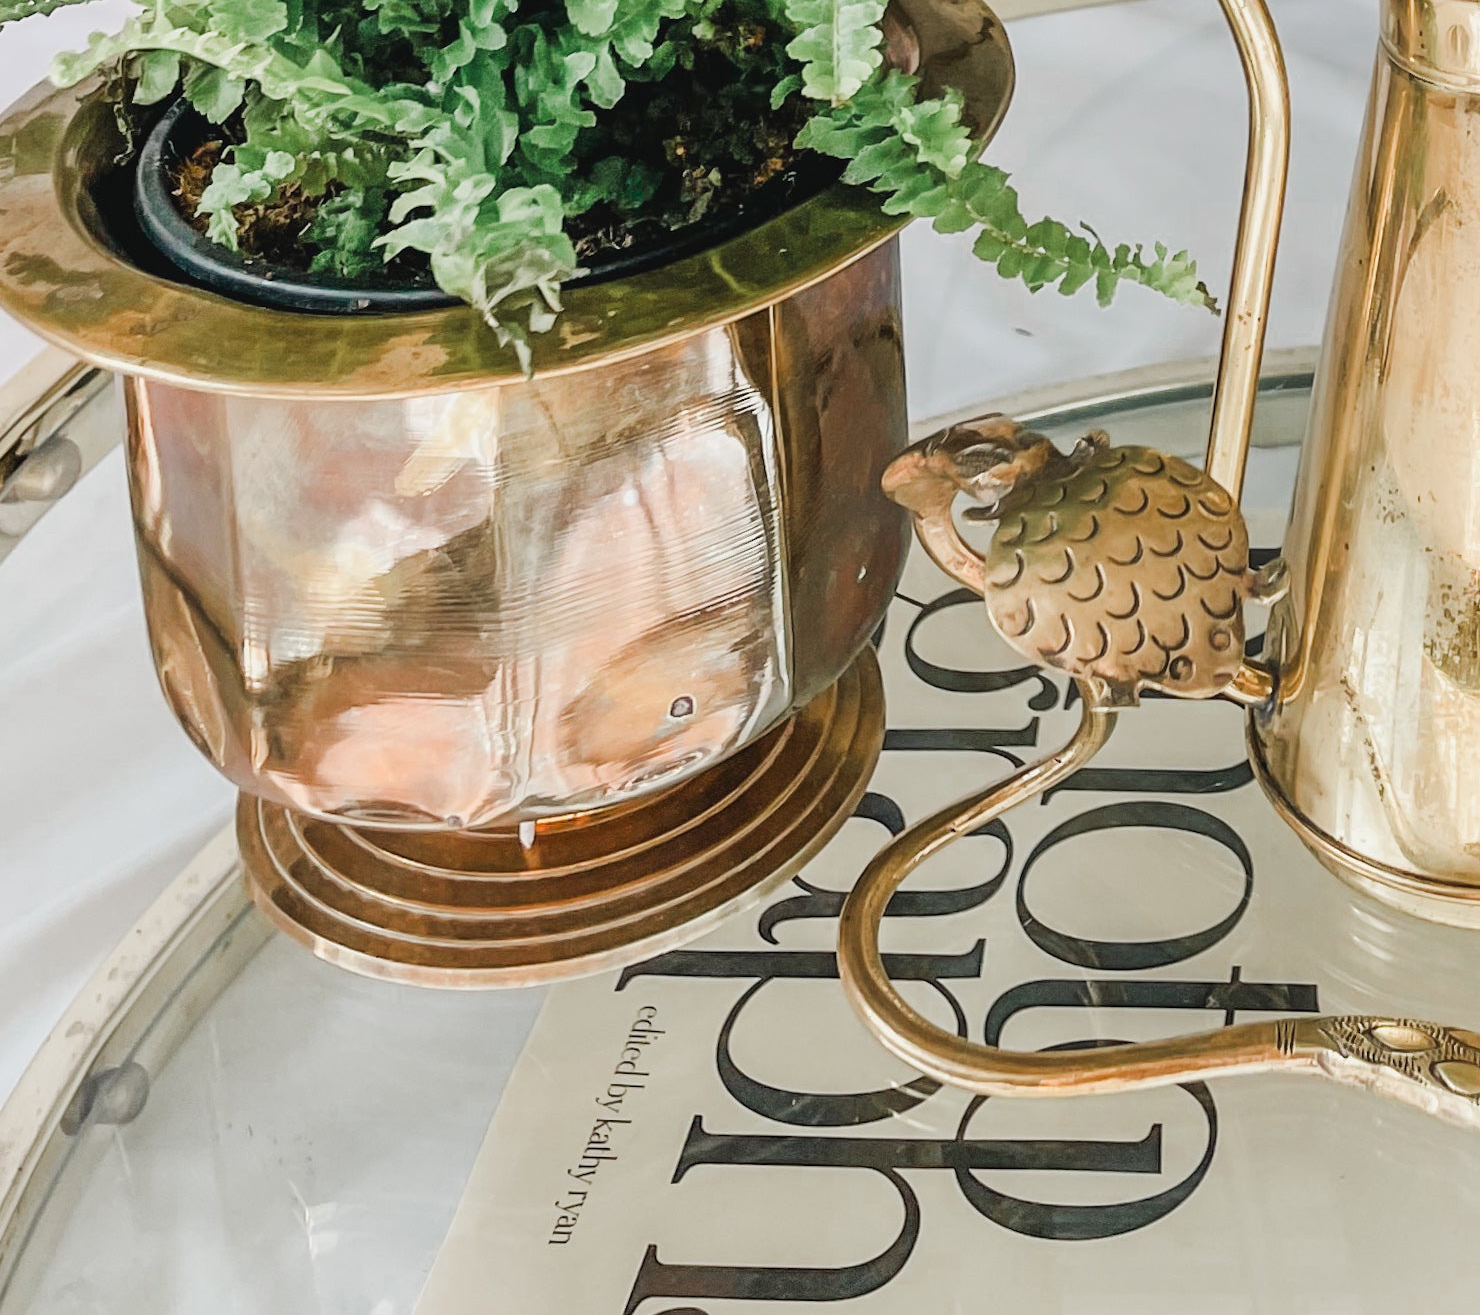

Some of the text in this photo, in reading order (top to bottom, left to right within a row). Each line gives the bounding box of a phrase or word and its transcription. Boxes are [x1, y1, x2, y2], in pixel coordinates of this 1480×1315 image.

[548, 1004, 666, 1246] edited by kathy ryan
[614, 586, 1163, 1315] raph
[954, 547, 1320, 1241] hoto
